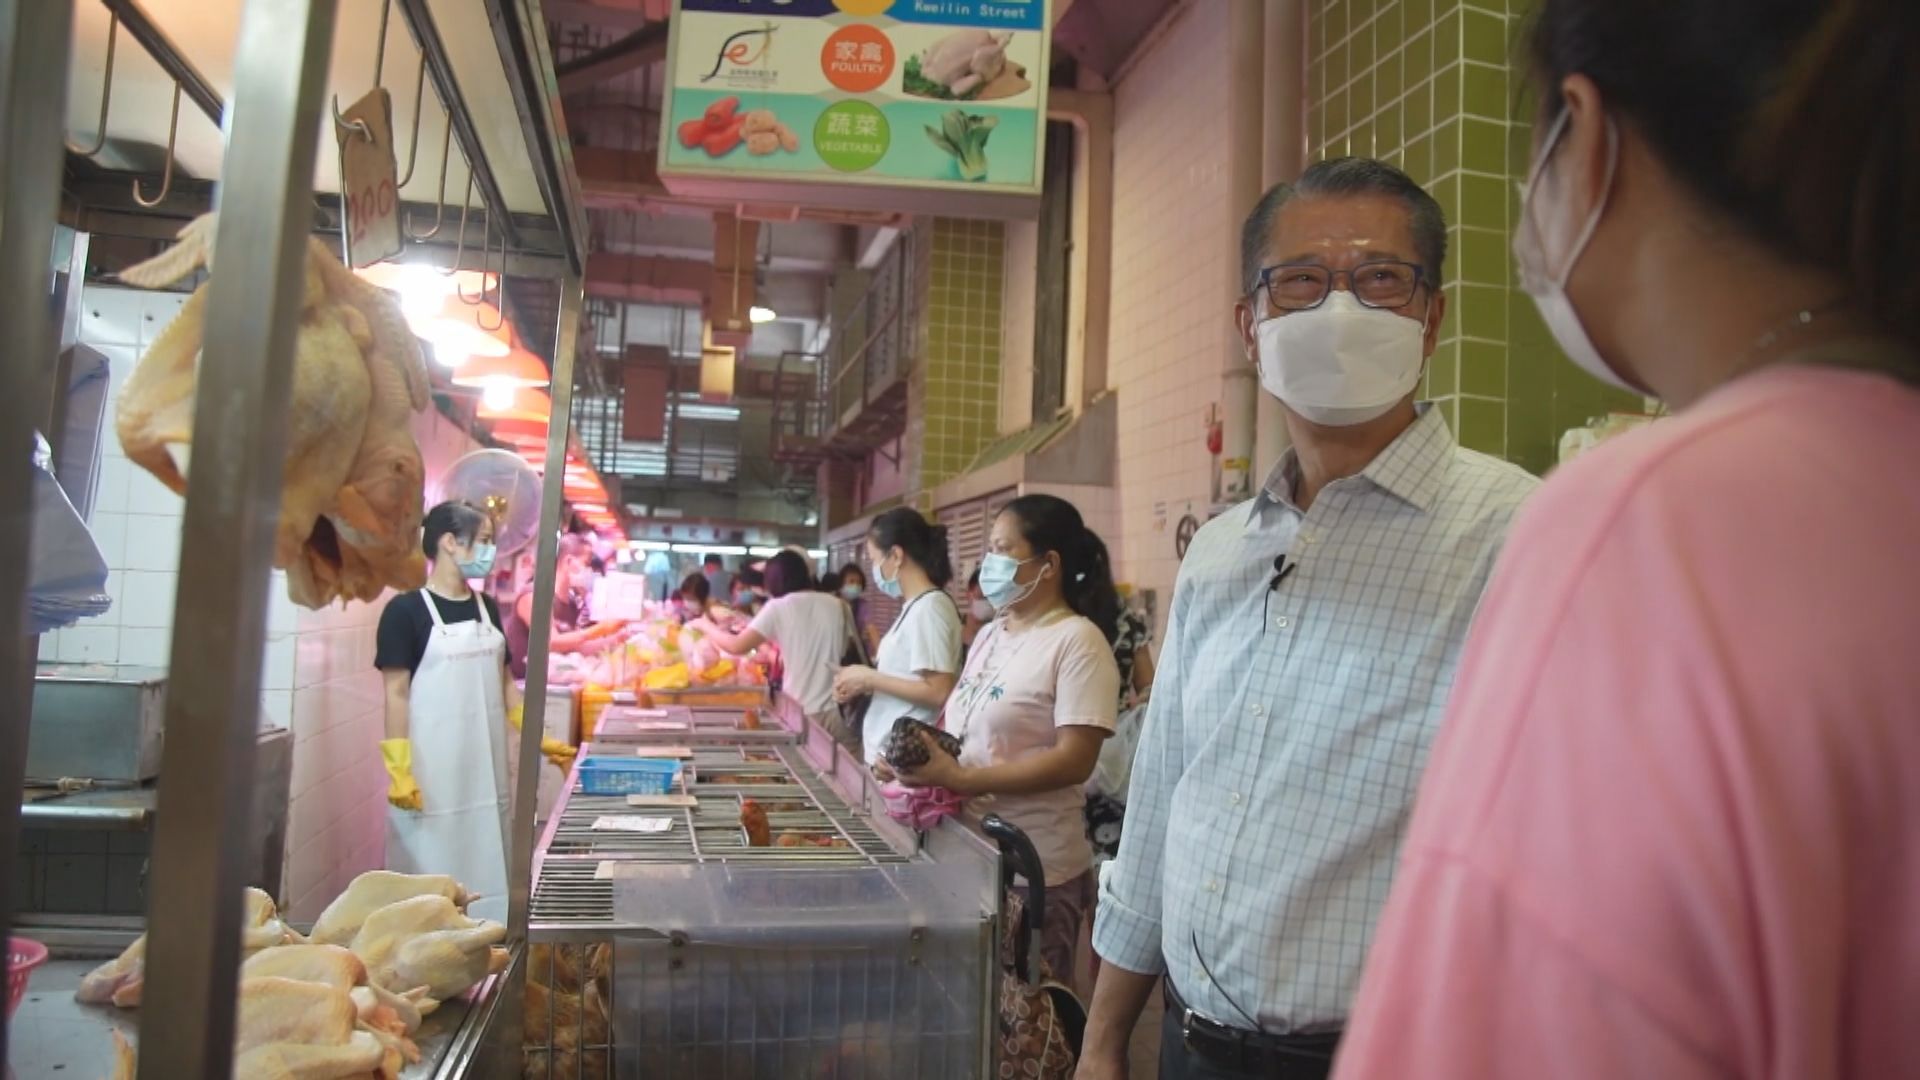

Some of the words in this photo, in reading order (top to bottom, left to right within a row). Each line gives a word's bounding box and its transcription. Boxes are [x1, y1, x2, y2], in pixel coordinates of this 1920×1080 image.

[914, 1, 970, 15] Kweilin
[979, 3, 1026, 19] Street
[835, 41, 882, 62] 家禽
[831, 61, 885, 74] POULTRY
[827, 111, 879, 136] 蔬菜
[820, 141, 882, 154] VEGETABLE
